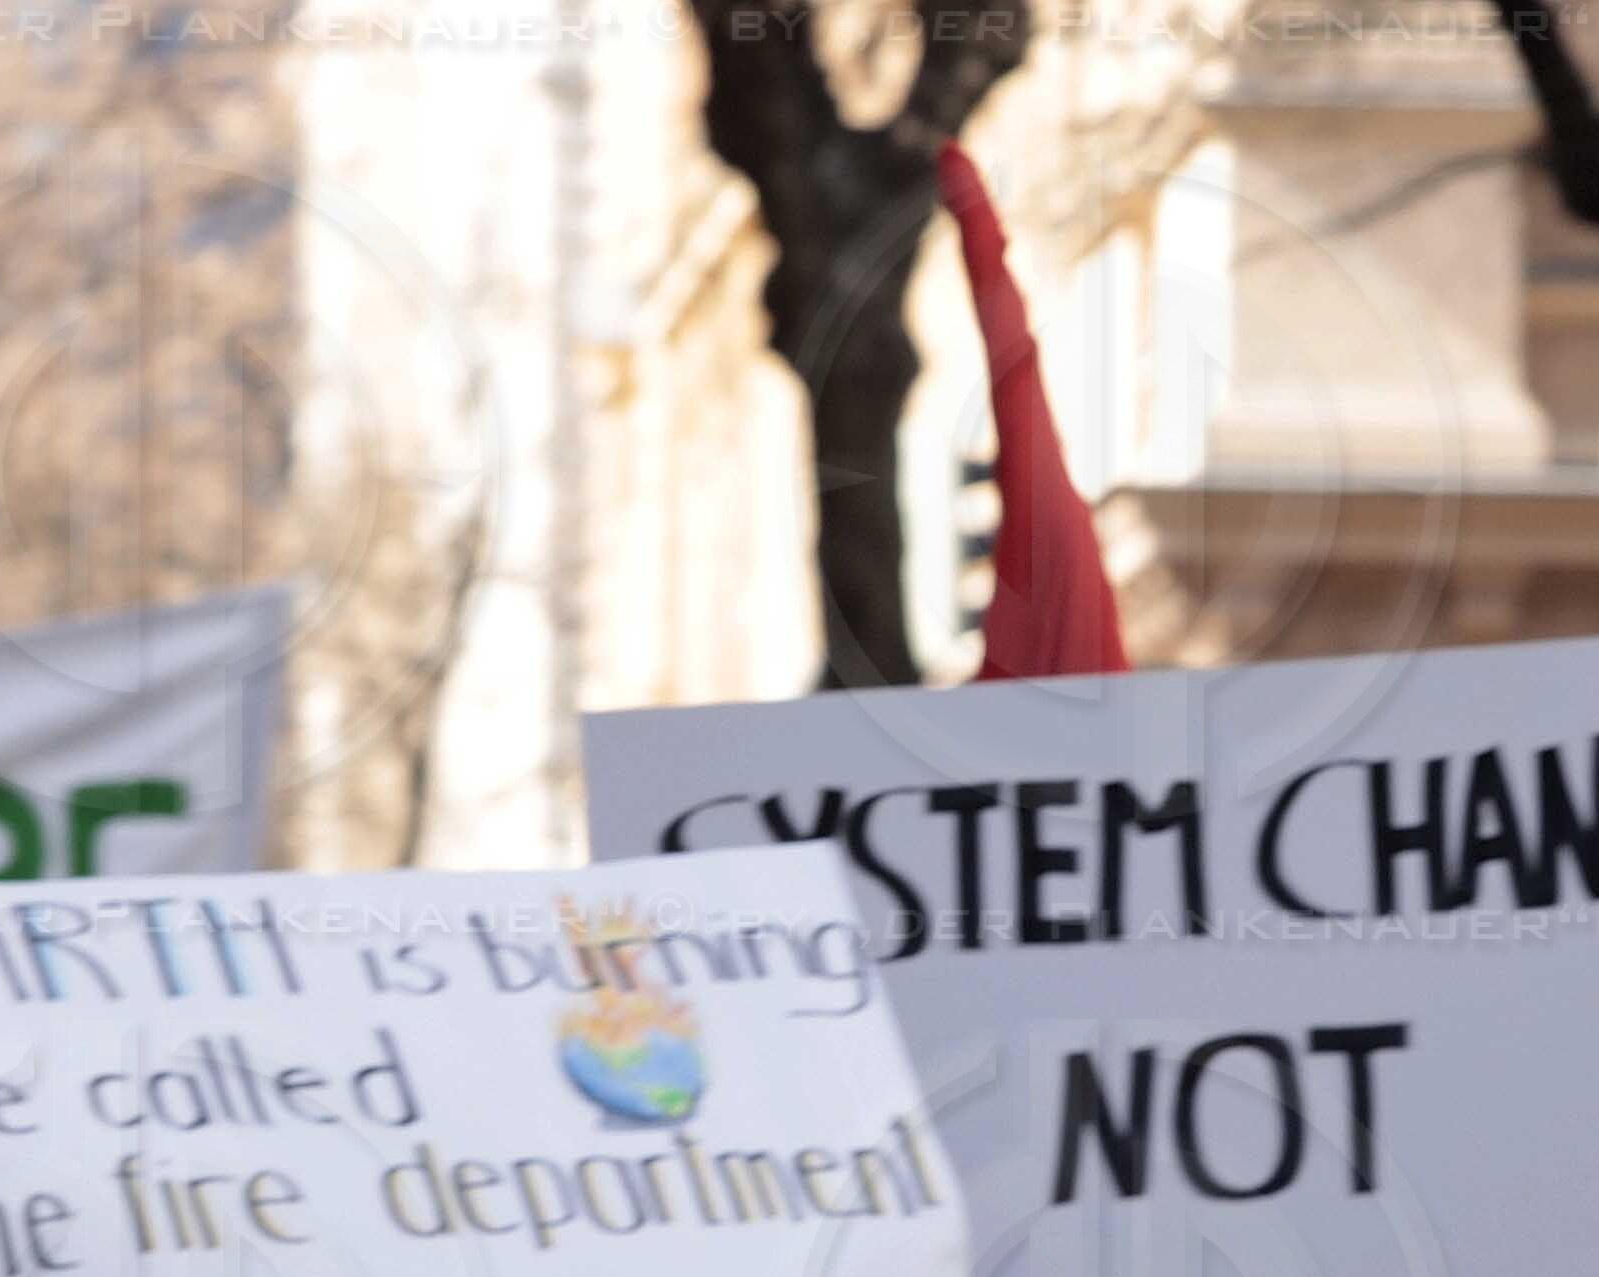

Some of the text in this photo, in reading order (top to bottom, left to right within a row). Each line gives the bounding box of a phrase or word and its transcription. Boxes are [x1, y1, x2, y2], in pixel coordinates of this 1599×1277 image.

[358, 942, 448, 996] is
[467, 911, 872, 1018] burning
[87, 1024, 421, 1131] called
[1051, 1022, 1412, 1206] NOT
[114, 1151, 310, 1254] fire
[380, 1113, 942, 1251] department
